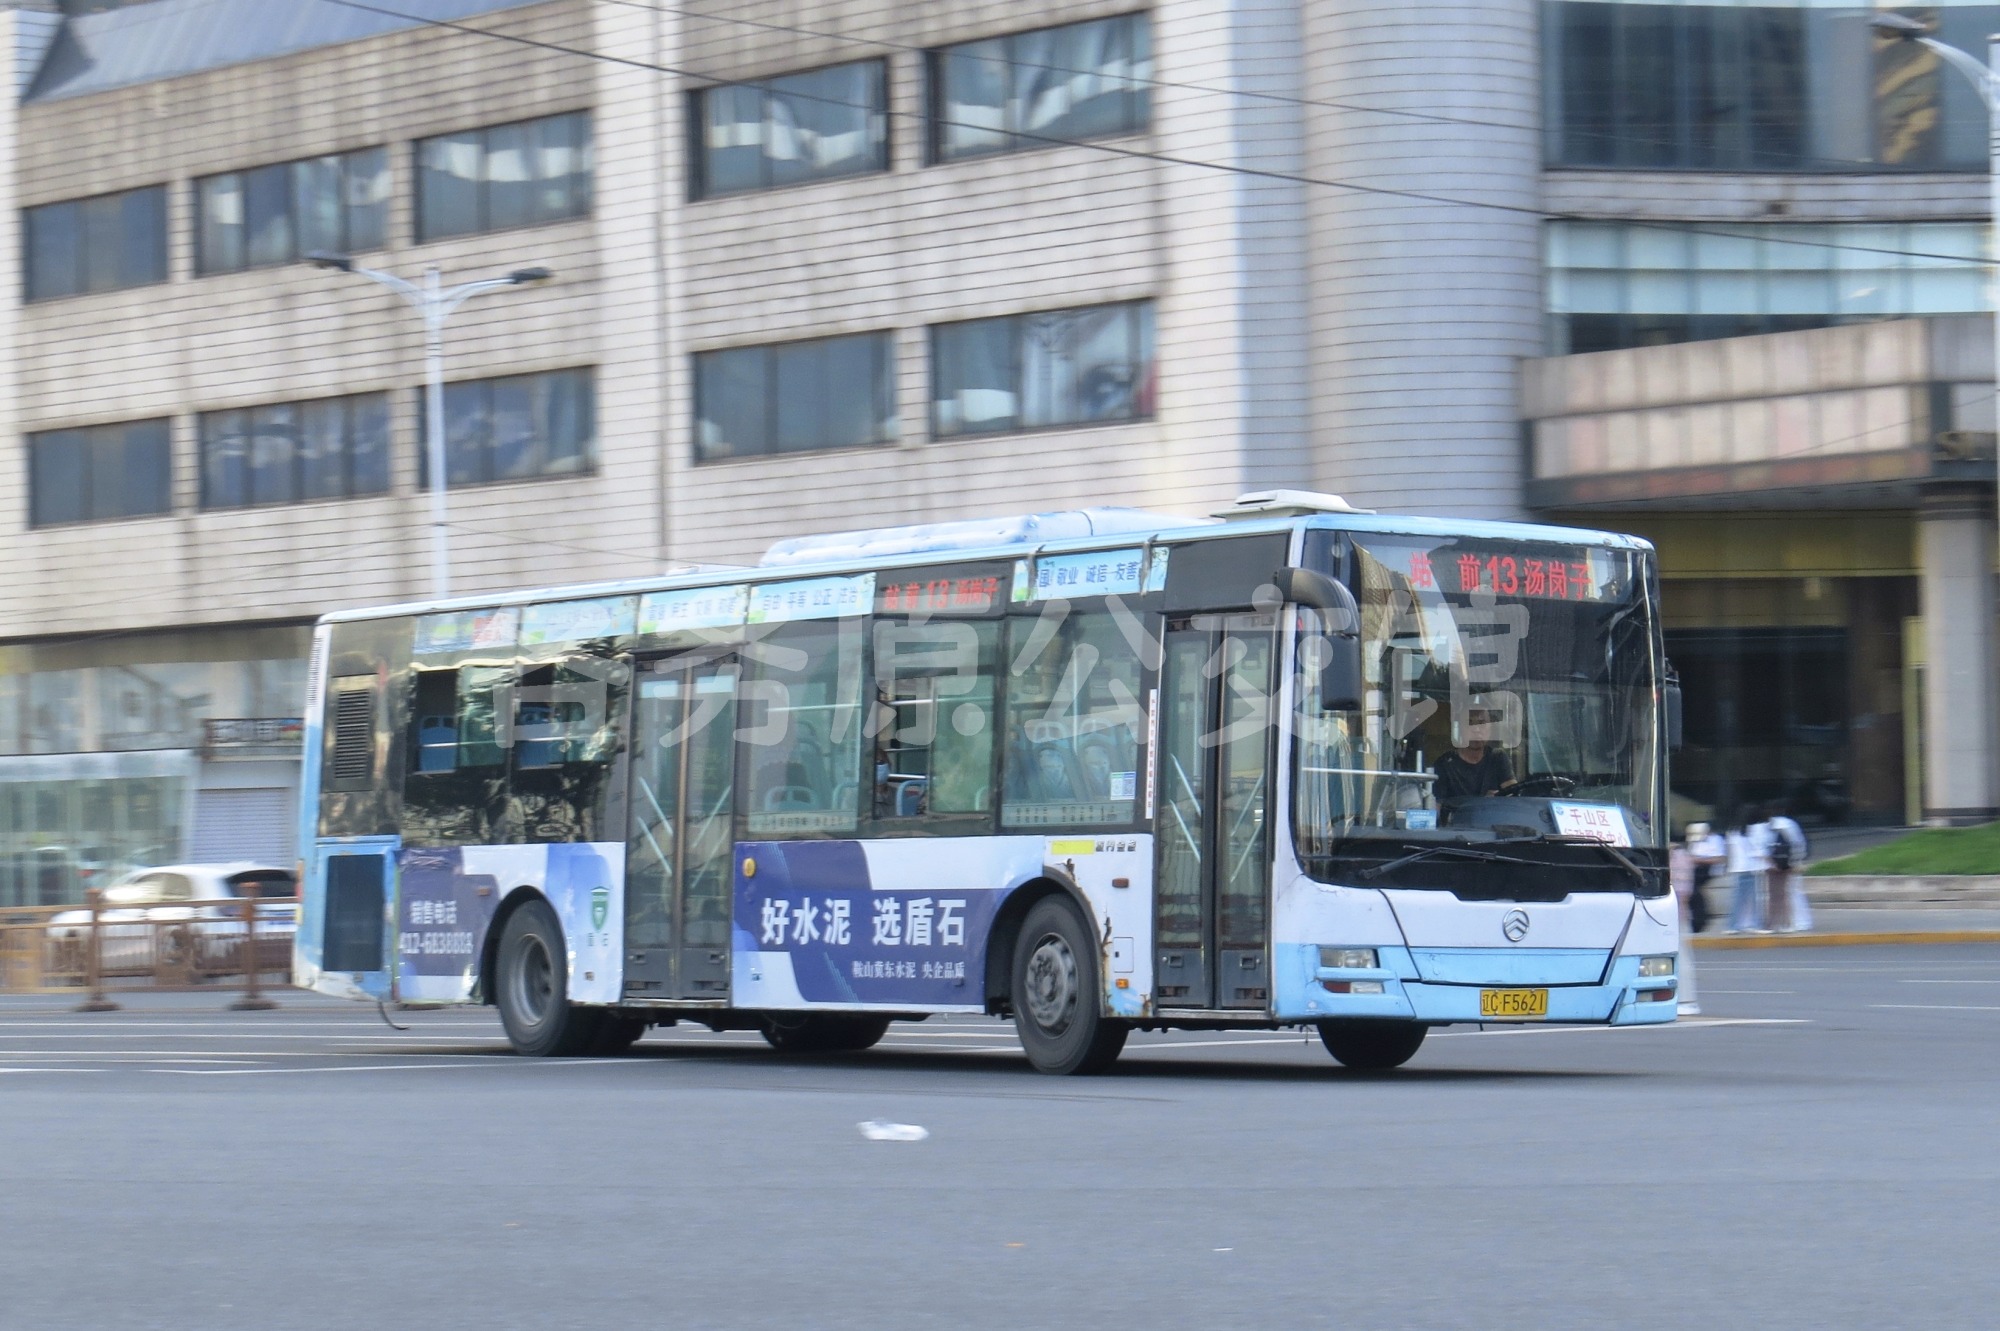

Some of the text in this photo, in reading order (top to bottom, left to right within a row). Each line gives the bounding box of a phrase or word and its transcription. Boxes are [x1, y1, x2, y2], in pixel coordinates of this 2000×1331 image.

[1057, 566, 1079, 586] 敬业
[1086, 564, 1107, 583] 诚信
[1116, 561, 1139, 581] 友善
[1570, 808, 1611, 827] 千山区
[761, 897, 967, 946] 好水泥 选盾石
[922, 961, 965, 979] 央企品质
